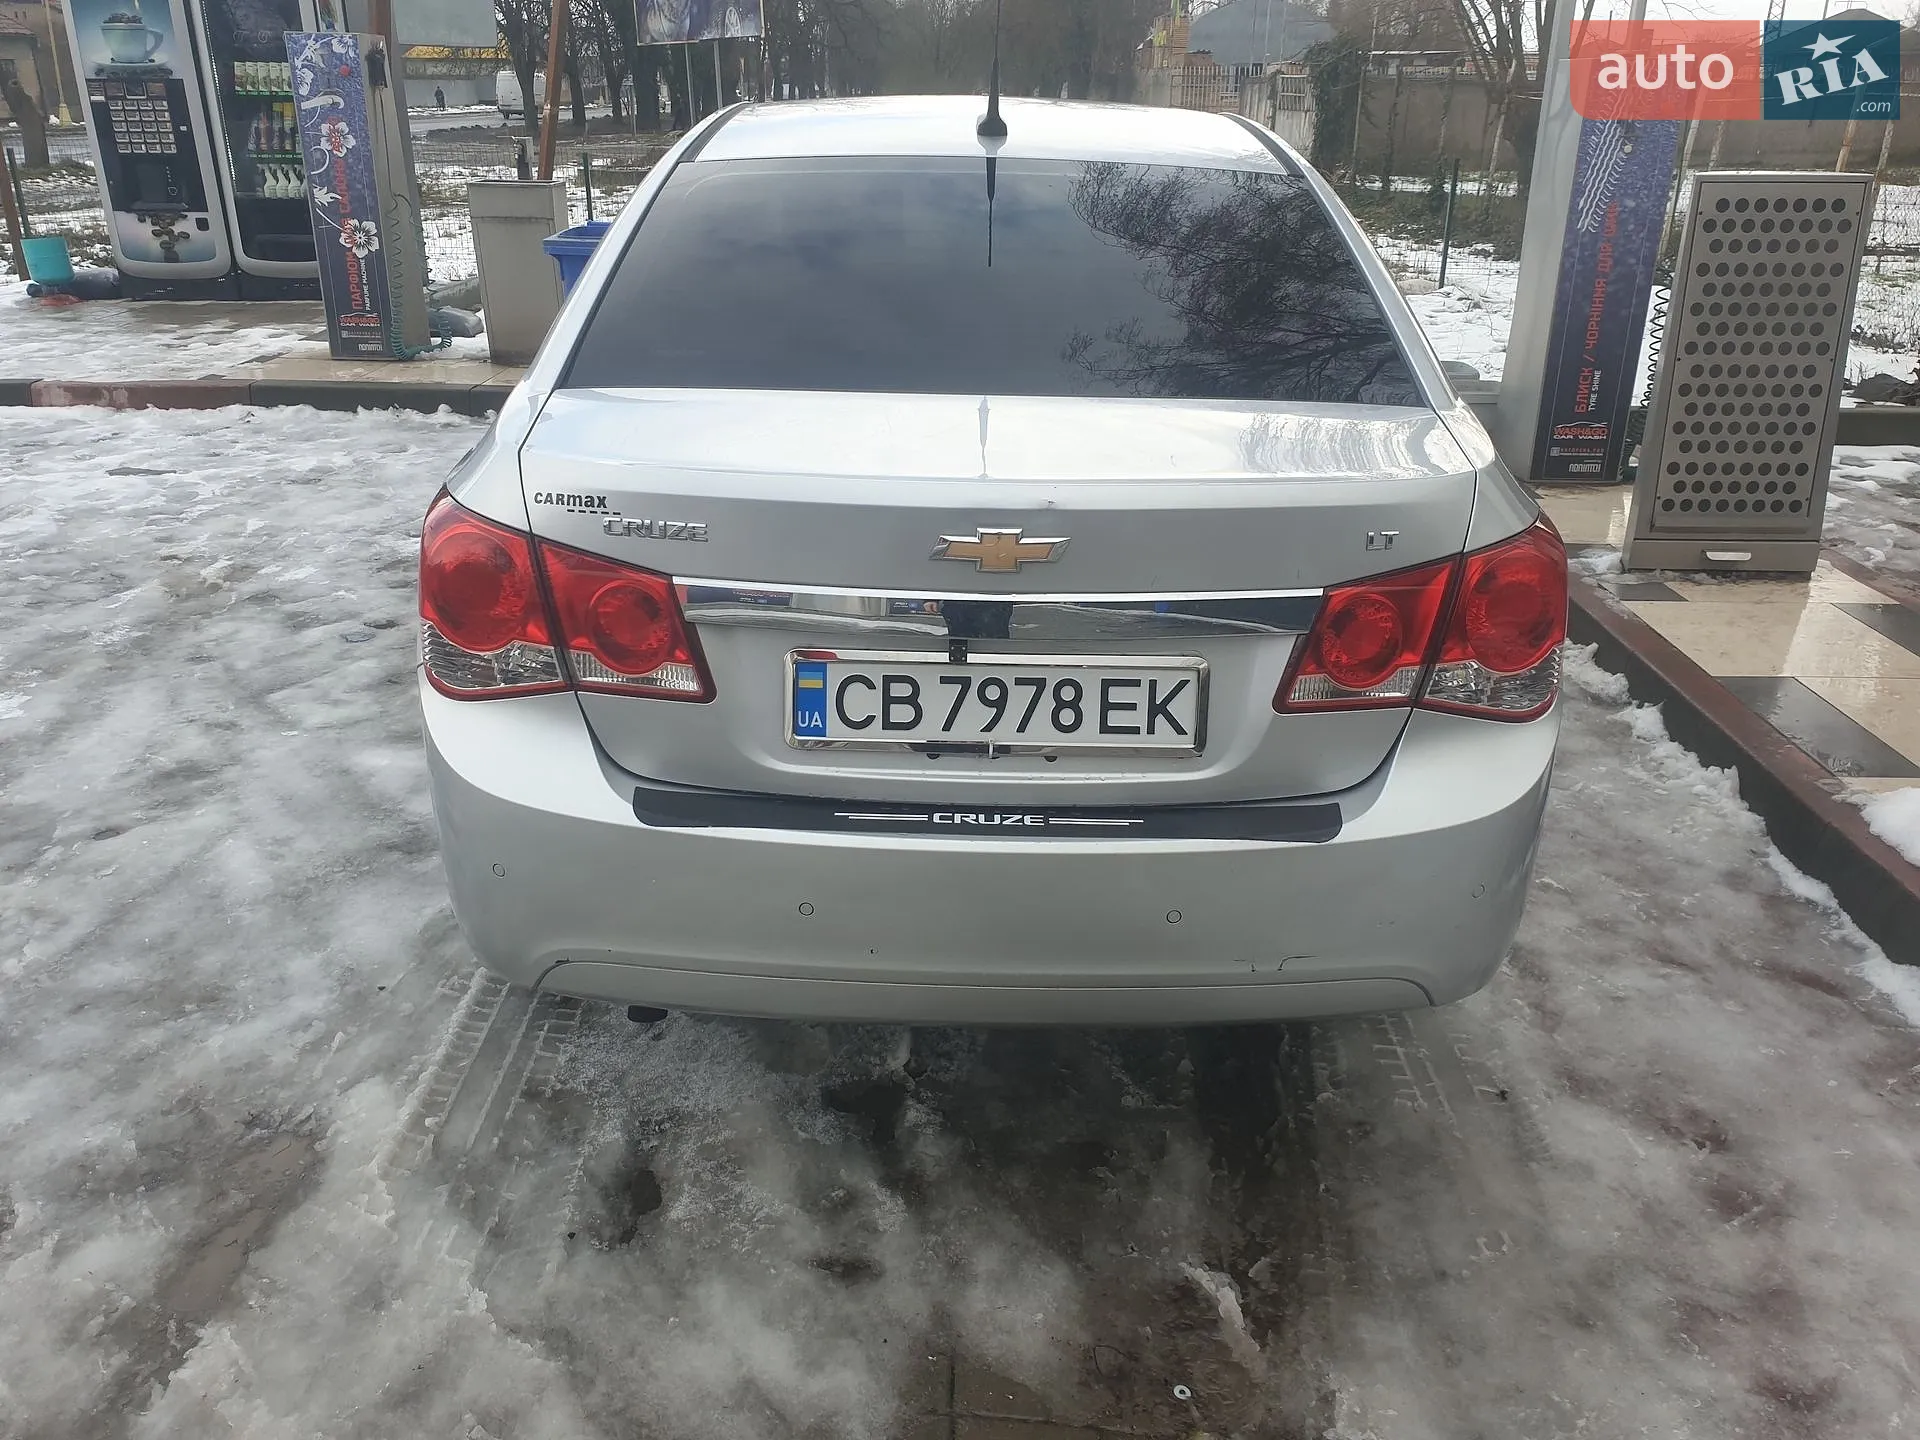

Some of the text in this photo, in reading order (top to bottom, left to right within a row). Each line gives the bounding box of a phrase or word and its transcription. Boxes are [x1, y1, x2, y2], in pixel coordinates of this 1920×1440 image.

[1575, 367, 1593, 413] БЛИСК
[1585, 278, 1608, 350] ЧОРНІННЯ
[1598, 243, 1613, 273] ДЛЯ
[1588, 369, 1602, 411] TYRE SHINE
[534, 492, 608, 509] CARmax
[602, 517, 709, 543] CRUZE
[1365, 530, 1401, 552] LT
[835, 673, 1191, 736] CB 7978 EK
[798, 710, 823, 728] UA
[932, 812, 1046, 826] CRUZE
